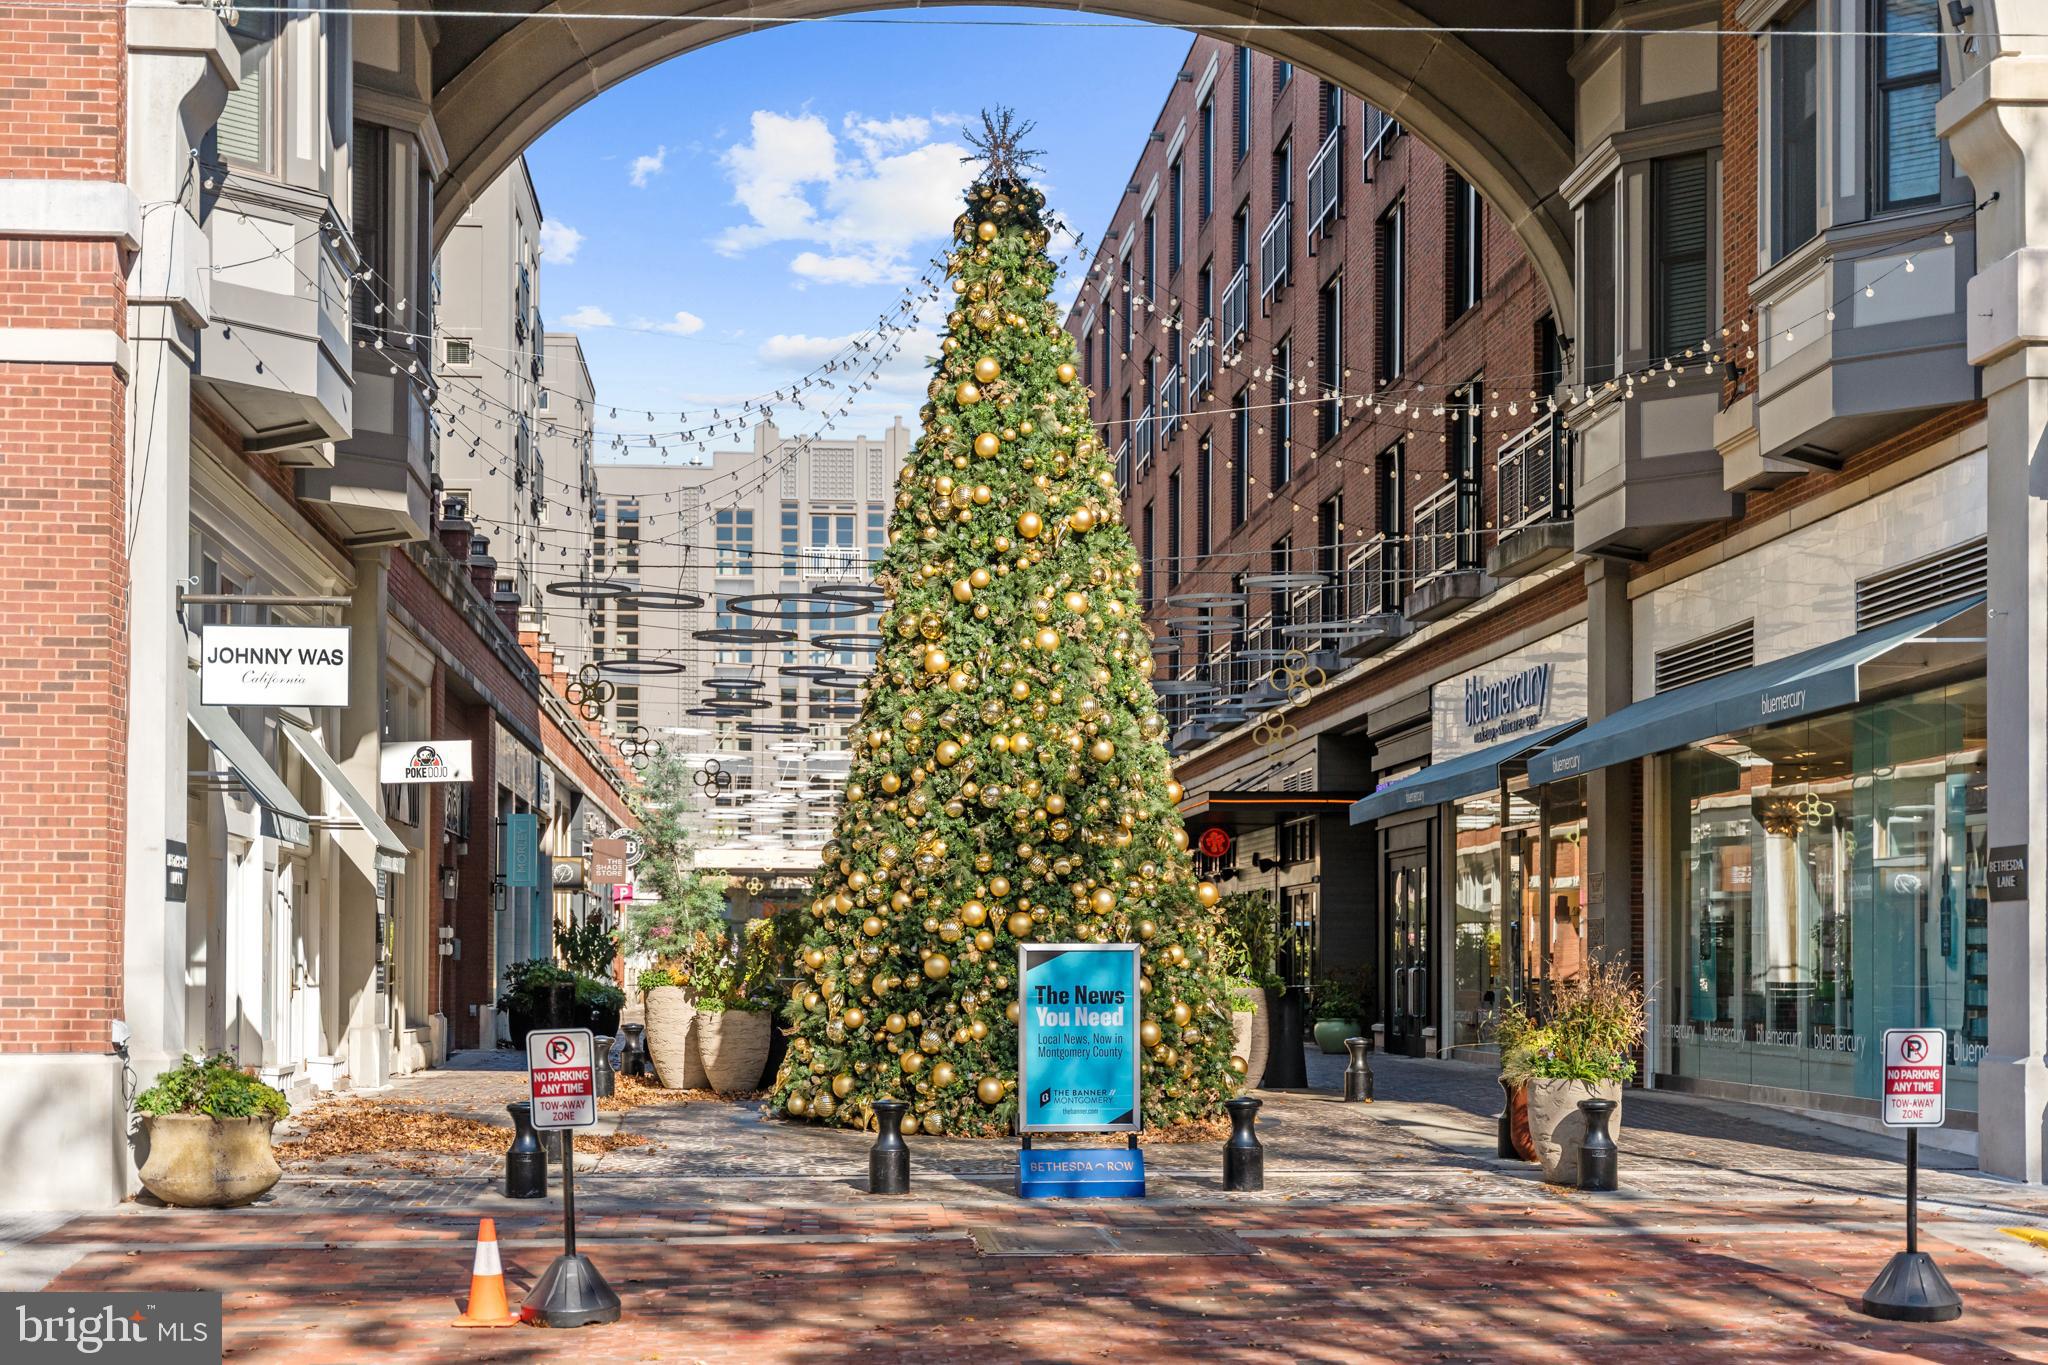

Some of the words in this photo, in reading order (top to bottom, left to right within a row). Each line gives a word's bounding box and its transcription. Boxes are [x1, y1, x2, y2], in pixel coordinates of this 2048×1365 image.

[207, 647, 293, 665] JOHNNY
[298, 648, 344, 666] WAS
[241, 669, 306, 689] California
[1465, 663, 1550, 727] bluemercury
[1761, 689, 1806, 715] bluemercury
[1552, 754, 1581, 773] bluemercury
[405, 767, 427, 778] POKE
[427, 766, 448, 778] DOJO
[516, 828, 528, 873] MORLEY
[626, 841, 637, 854] B
[595, 864, 623, 872] SHADE
[1989, 859, 2024, 872] BETHESDA
[1997, 876, 2016, 888] LANE
[1035, 985, 1070, 1005] The
[1074, 985, 1125, 1005] News
[1036, 1006, 1070, 1027] You
[1075, 1006, 1124, 1027] Need
[1038, 1033, 1060, 1045] Local
[1063, 1034, 1090, 1046] News,
[1093, 1033, 1113, 1044] Now
[1115, 1033, 1123, 1044] in
[1704, 1020, 1747, 1048] bluemercury
[1755, 1024, 1803, 1055] bluemercury
[1814, 1027, 1866, 1062] bluemercury
[1038, 1047, 1091, 1060] Montgomery
[1093, 1046, 1123, 1060] County
[534, 1072, 547, 1082] NO
[548, 1070, 590, 1081] PARKING
[1888, 1070, 1900, 1079] NO
[1901, 1070, 1940, 1080] PARKING
[541, 1084, 561, 1095] ANY
[562, 1083, 584, 1093] TIME
[1053, 1089, 1070, 1097] THE
[1072, 1089, 1107, 1097] BANNER
[1893, 1082, 1912, 1092] ANY
[1913, 1082, 1934, 1092] TIME
[541, 1100, 586, 1110] TOW-AWAY
[1053, 1096, 1114, 1105] MONTGOMERY
[1892, 1099, 1935, 1108] TOW-AWAY
[553, 1111, 575, 1121] ZONE
[1062, 1107, 1099, 1115] thebanner.com
[1902, 1110, 1923, 1119] ZONE
[1030, 1161, 1094, 1172] BETHESDA
[1107, 1161, 1134, 1171] ROW
